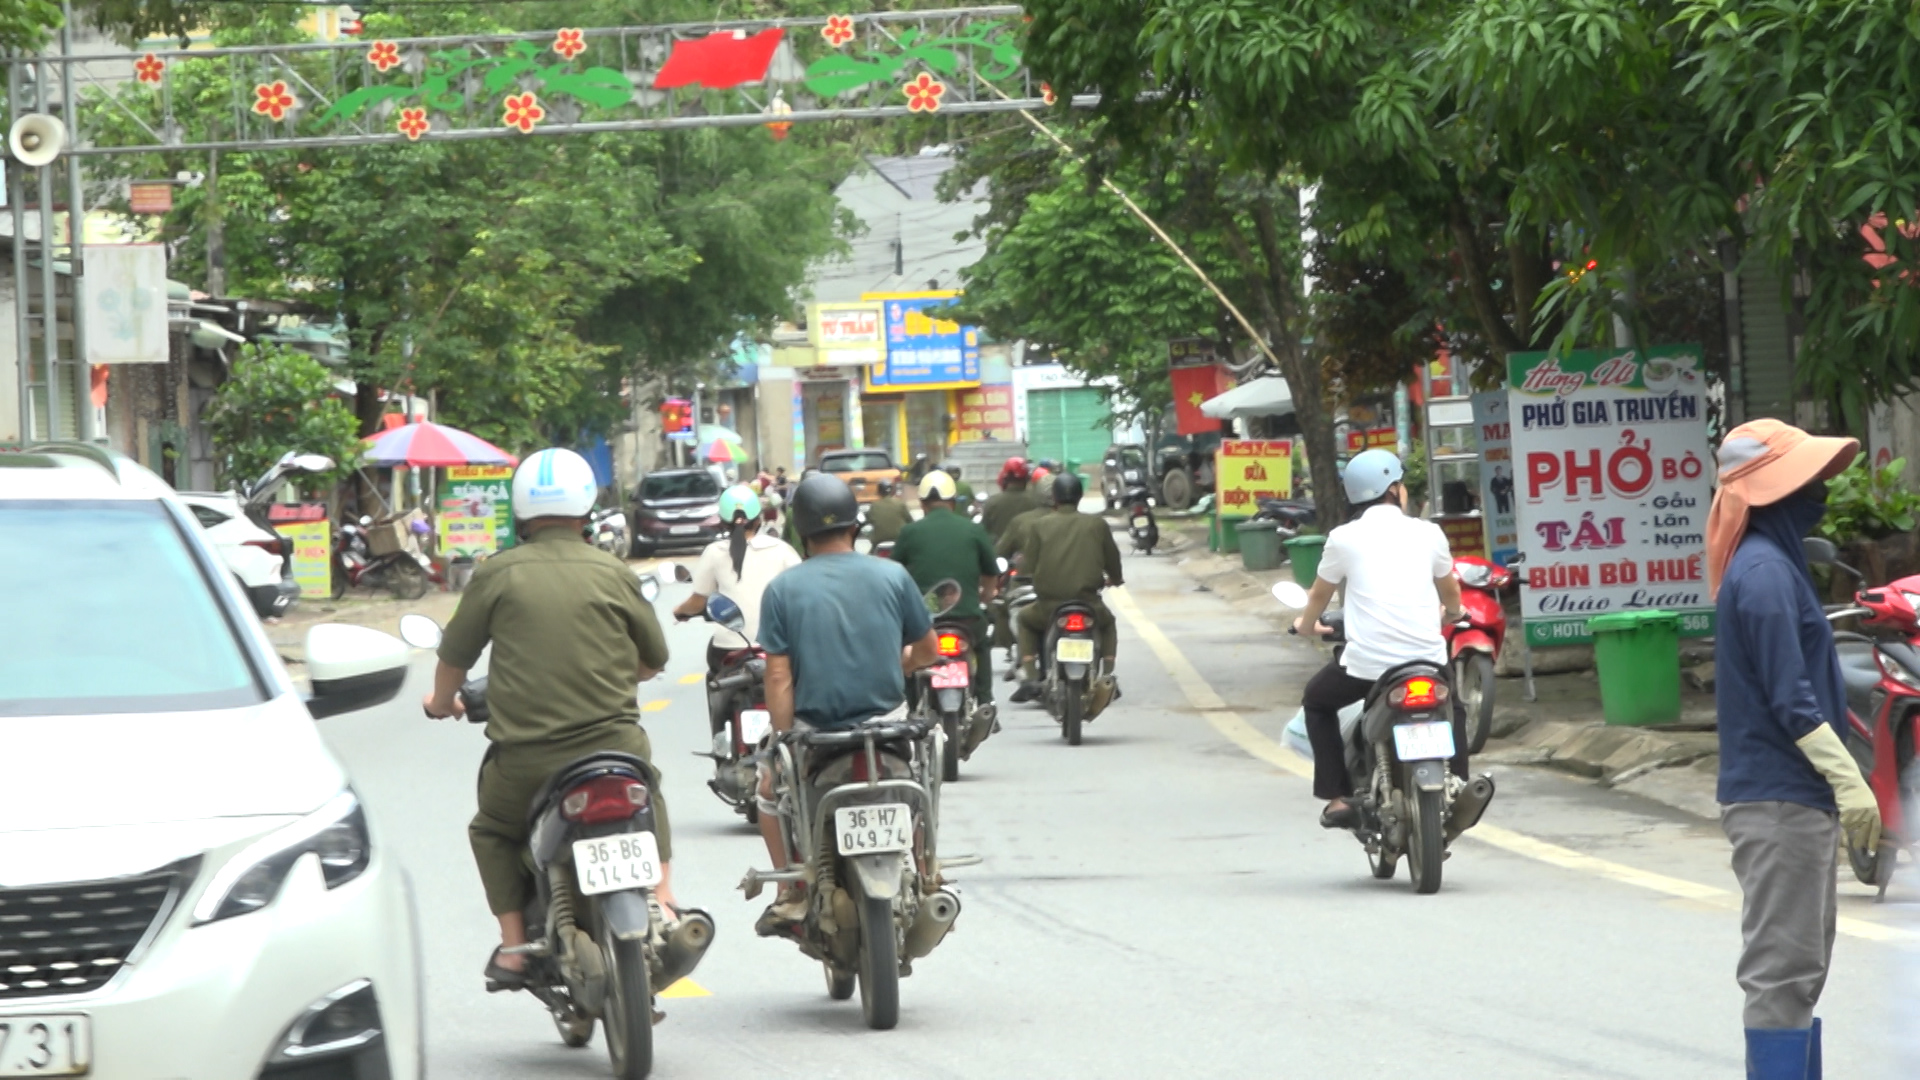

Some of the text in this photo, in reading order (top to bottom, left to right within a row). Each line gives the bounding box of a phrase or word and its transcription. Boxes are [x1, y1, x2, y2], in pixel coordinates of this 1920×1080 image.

[1522, 390, 1697, 428] PHỞ GIA TRUYỀN
[1527, 429, 1702, 499] PHỞ BÒ
[1535, 511, 1627, 551] TÁI
[1655, 533, 1703, 549] Nạm
[1529, 552, 1706, 589] BÚN BÒ HUẾ
[1539, 589, 1699, 614] Cháo Lươn
